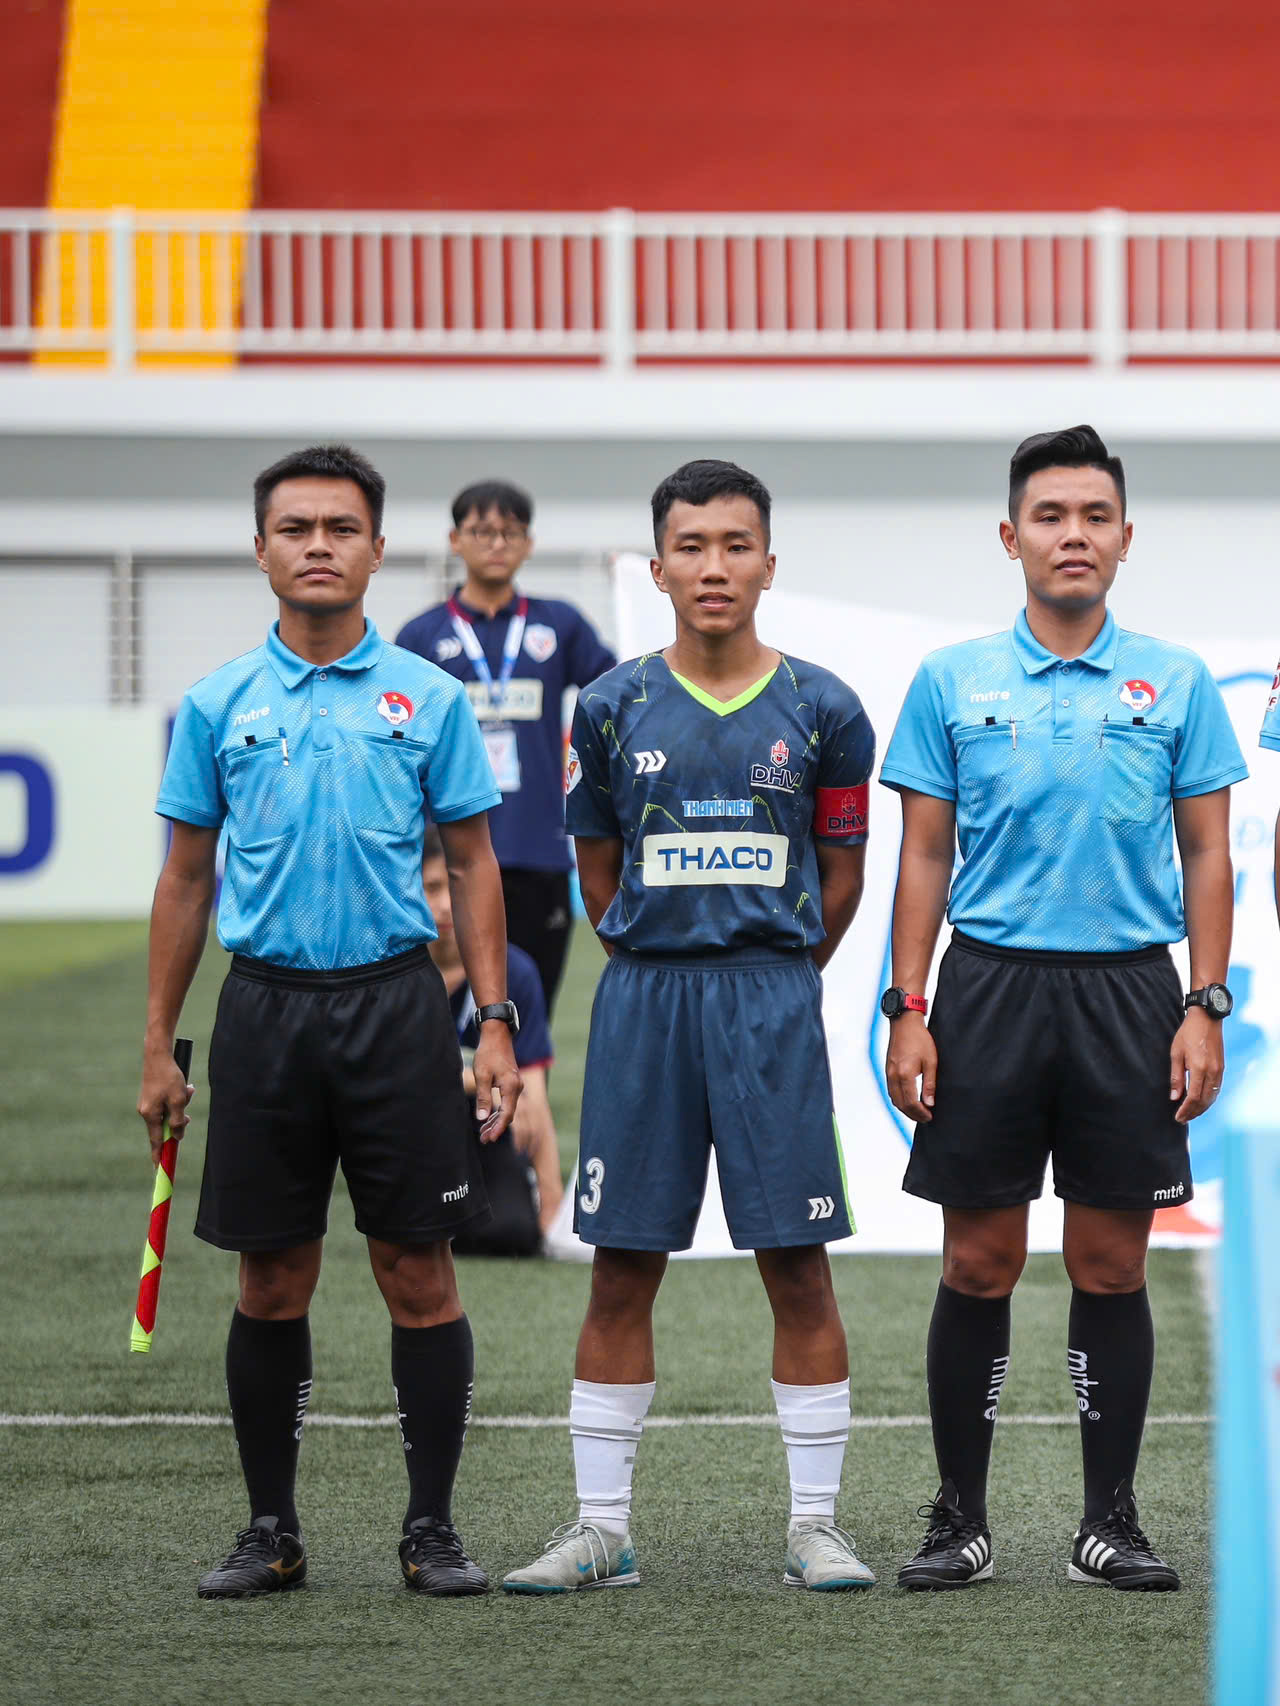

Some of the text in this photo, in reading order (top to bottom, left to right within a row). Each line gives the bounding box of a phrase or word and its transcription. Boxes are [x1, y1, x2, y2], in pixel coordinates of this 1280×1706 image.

[970, 689, 1011, 704] mitre
[234, 705, 270, 728] mitre
[751, 763, 800, 789] DHV
[682, 800, 726, 817] THANH
[827, 815, 866, 830] DHV
[657, 846, 773, 871] THACO
[581, 1157, 605, 1214] 3
